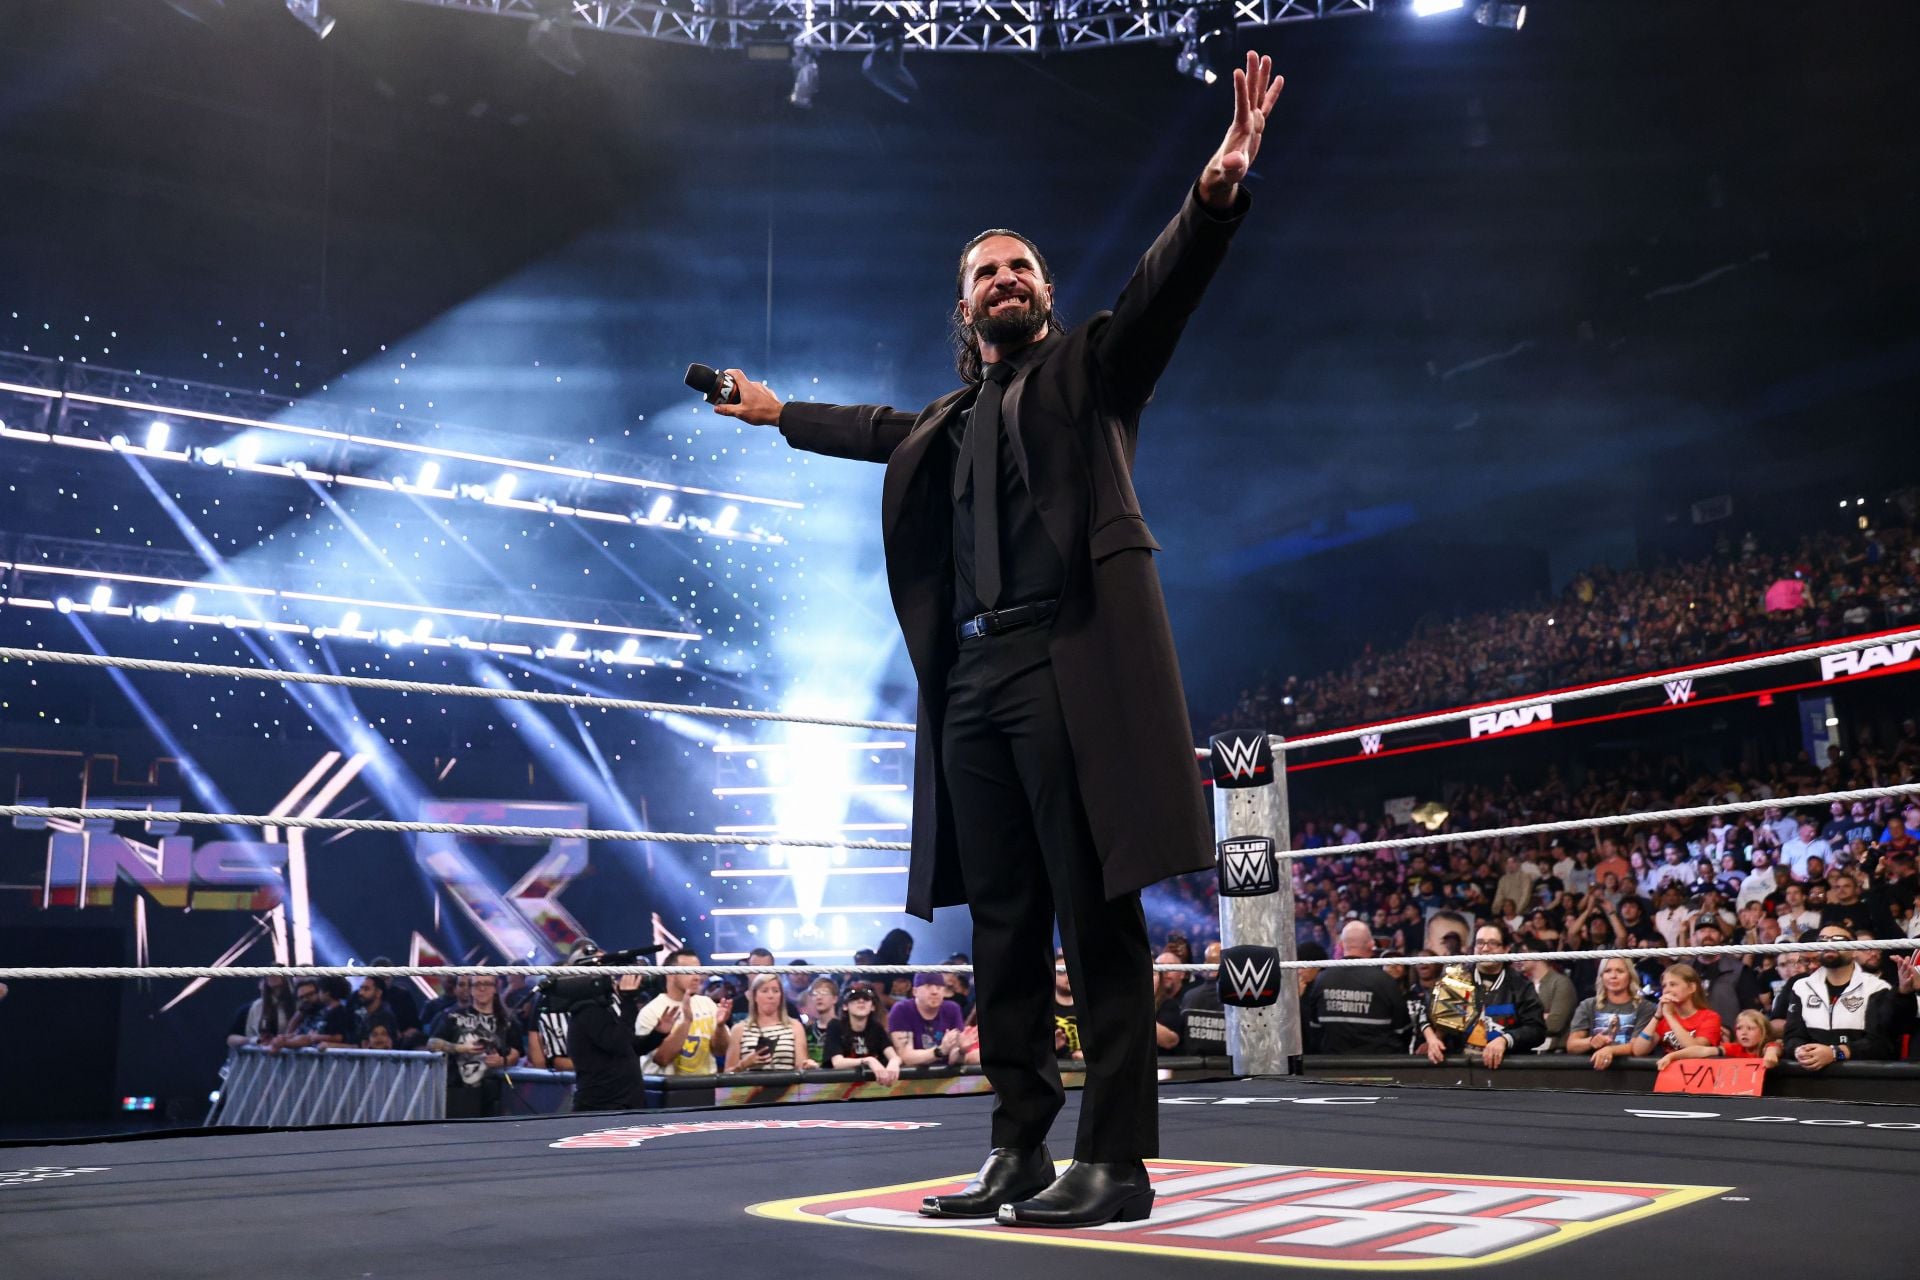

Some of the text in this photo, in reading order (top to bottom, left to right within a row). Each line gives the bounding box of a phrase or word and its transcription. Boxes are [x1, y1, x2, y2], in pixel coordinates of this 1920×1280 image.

[1469, 703, 1553, 739] RAW
[1225, 842, 1267, 853] CLUB
[1323, 988, 1373, 1002] ROSEMONT
[1326, 1000, 1370, 1014] SECURITY
[1187, 1015, 1225, 1030] ROSEMO
[1189, 1027, 1226, 1041] SECURIT
[1158, 1096, 1382, 1105] KFC
